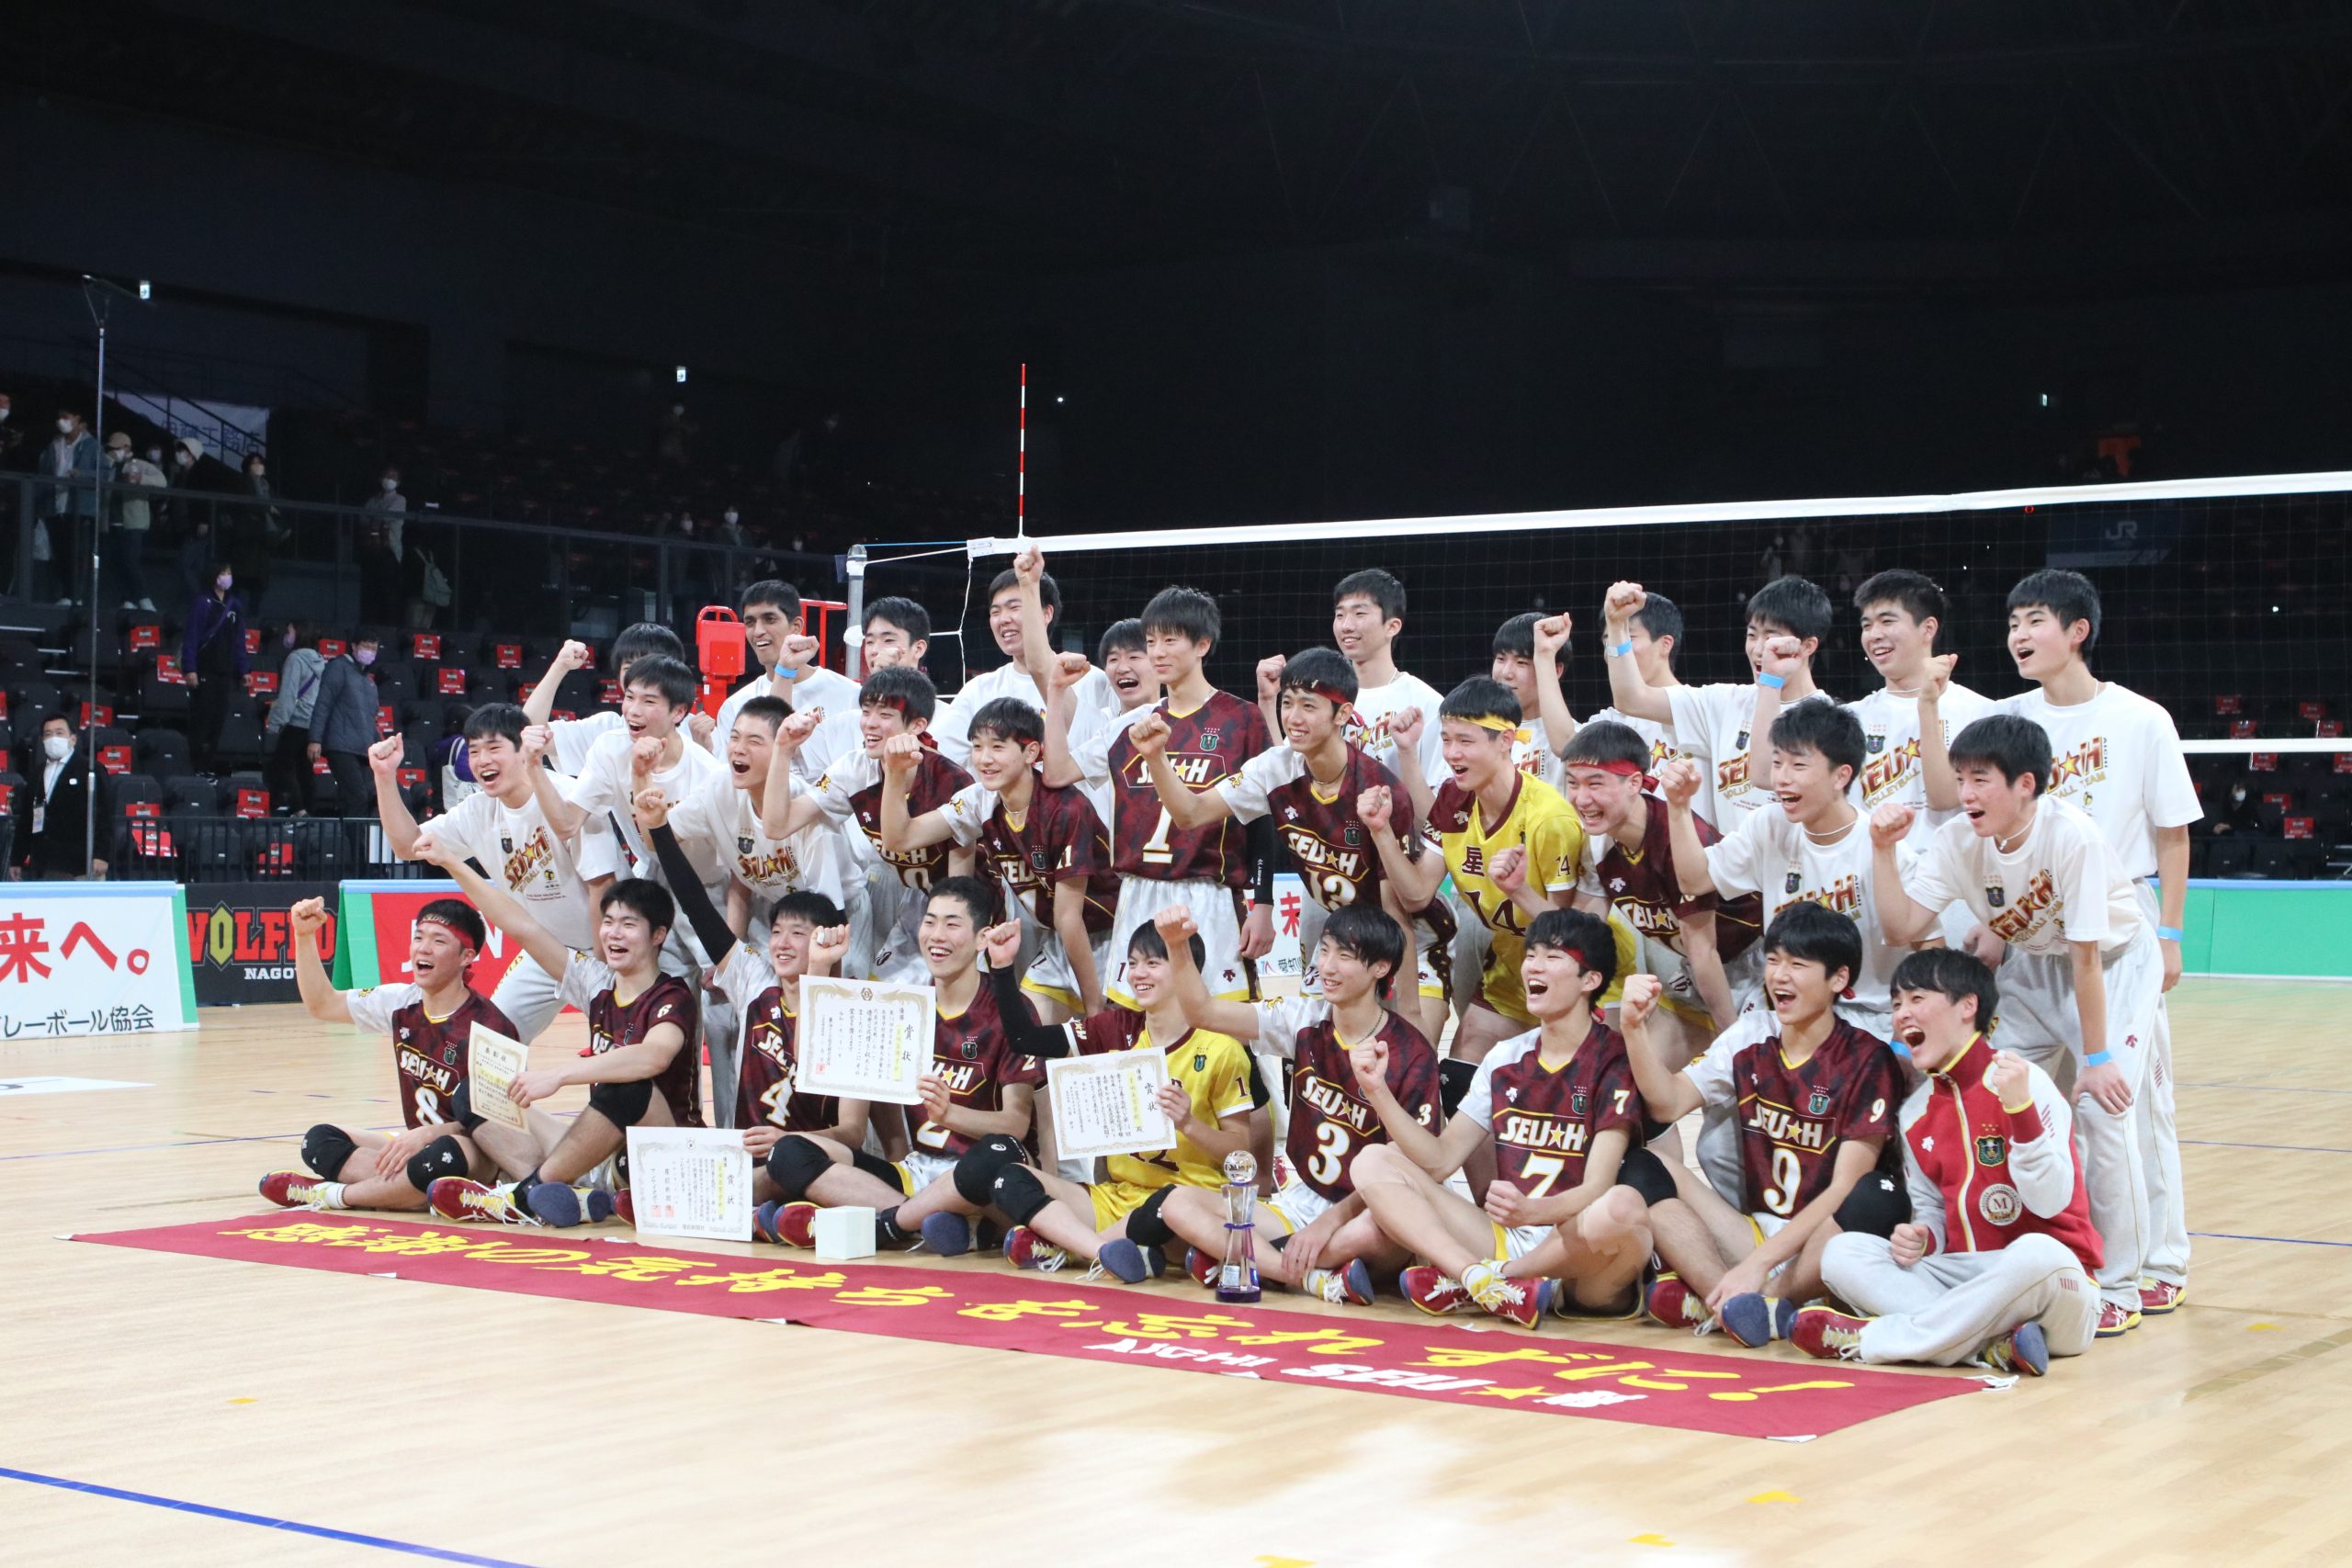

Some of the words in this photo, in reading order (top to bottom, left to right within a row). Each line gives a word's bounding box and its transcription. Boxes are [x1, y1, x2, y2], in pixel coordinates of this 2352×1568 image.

[1461, 845, 1486, 878] 星
[1555, 854, 1571, 877] 14
[1464, 890, 1527, 937] 14
[0, 1004, 155, 1039] レーボール協会
[657, 1004, 673, 1018] 6
[759, 1076, 794, 1127] 4
[1235, 1076, 1249, 1098] 1
[1613, 1089, 1631, 1115] 7
[415, 1086, 445, 1127] 8
[1417, 1103, 1433, 1126] 3
[1869, 1098, 1886, 1123] 9
[1308, 1122, 1351, 1186] 3
[1520, 1152, 1566, 1199] 7
[1763, 1147, 1802, 1214] 9
[1082, 1337, 1279, 1368] AICHI
